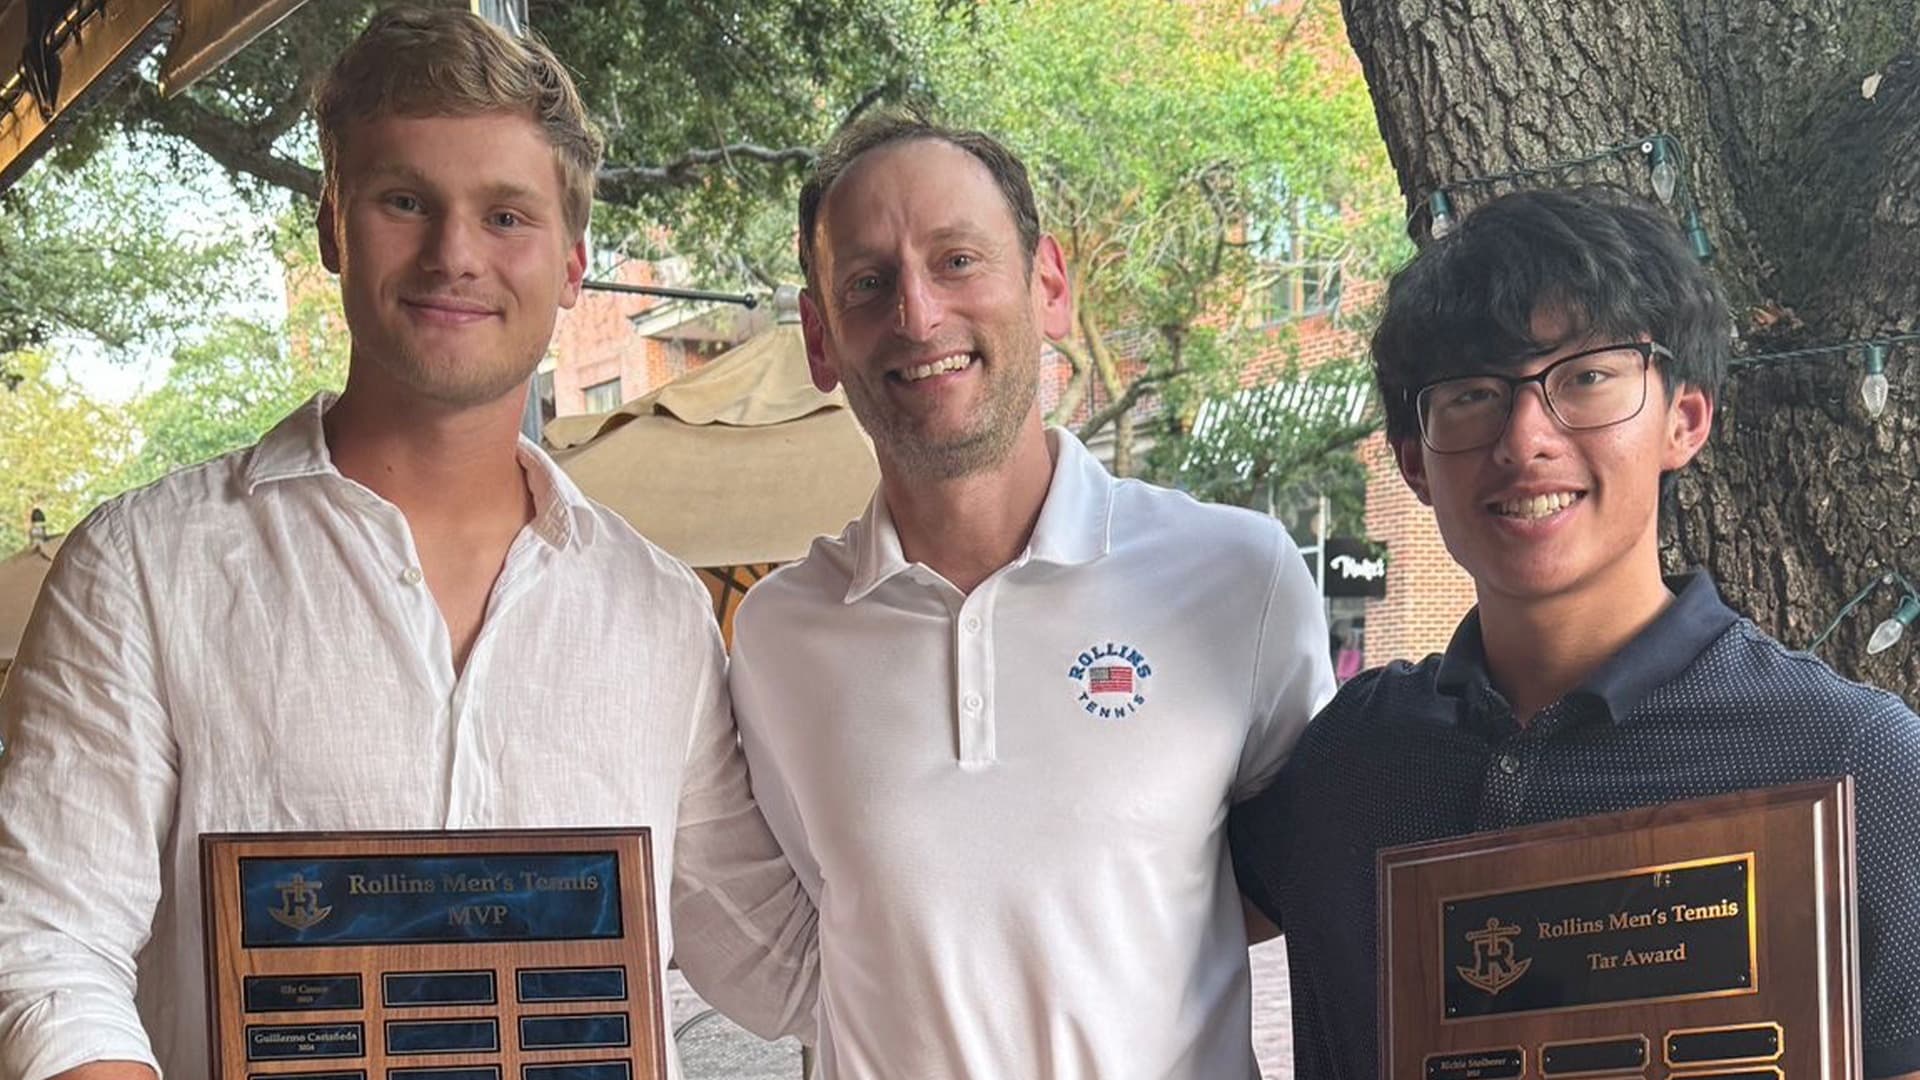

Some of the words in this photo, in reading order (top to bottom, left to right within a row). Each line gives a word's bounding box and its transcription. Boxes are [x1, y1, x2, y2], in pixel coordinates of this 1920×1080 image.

[1069, 643, 1152, 680] ROLLINS
[1079, 691, 1145, 718] TENNIS
[349, 874, 434, 896] Rollins
[443, 871, 513, 893] Men's
[521, 870, 599, 891] Tennis
[447, 905, 508, 927] MVP
[1538, 919, 1604, 940] Rollins
[1608, 907, 1667, 931] Men's
[1671, 898, 1739, 922] Tennis
[1586, 953, 1617, 971] Tar
[1622, 943, 1686, 967] Award
[254, 1033, 306, 1044] Guillermo
